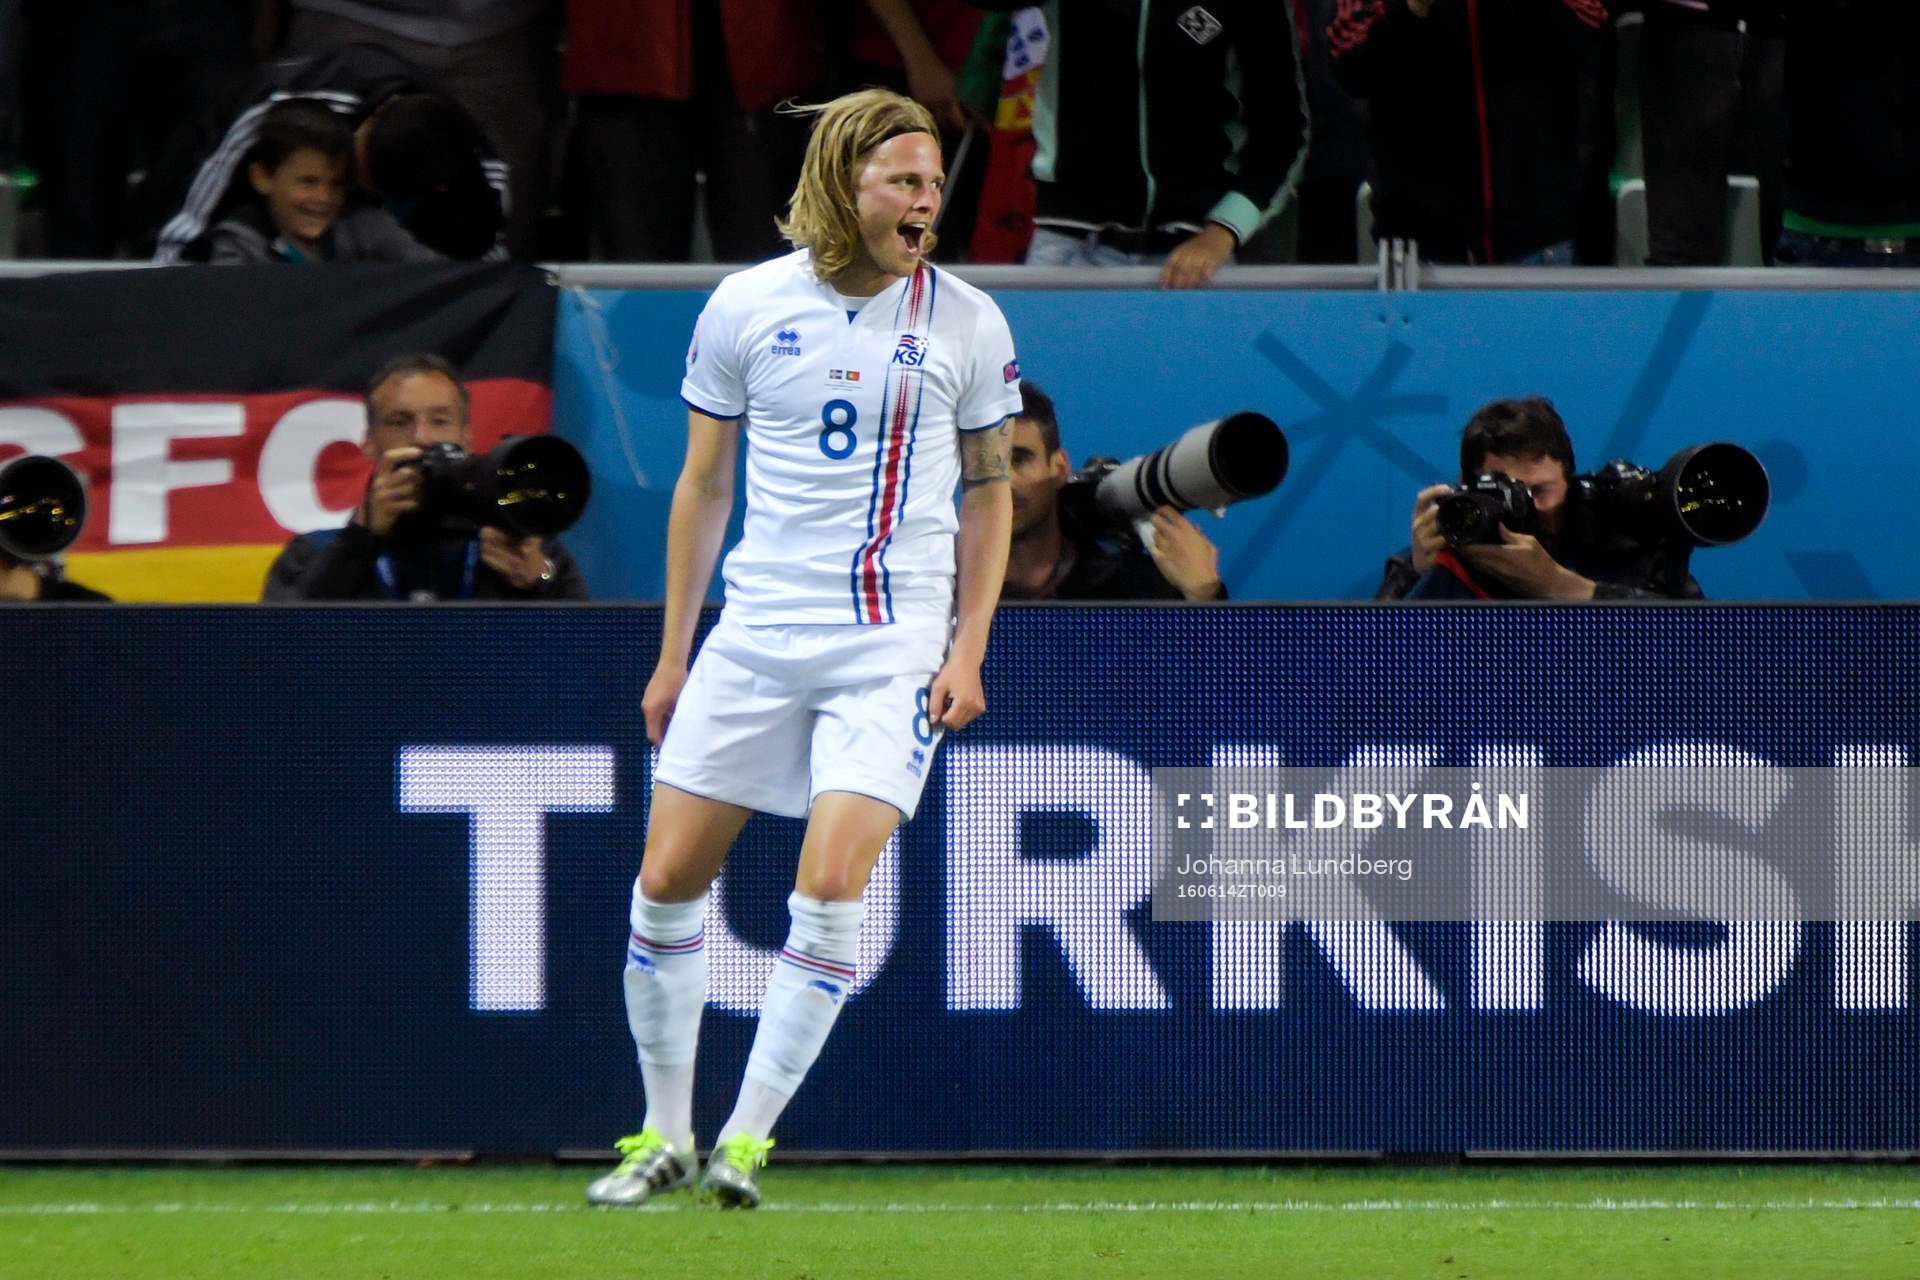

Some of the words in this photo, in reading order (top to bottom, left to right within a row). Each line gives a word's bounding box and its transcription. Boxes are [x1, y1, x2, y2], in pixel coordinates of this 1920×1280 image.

[819, 398, 858, 460] 8
[0, 399, 373, 545] FC
[912, 687, 934, 747] 8
